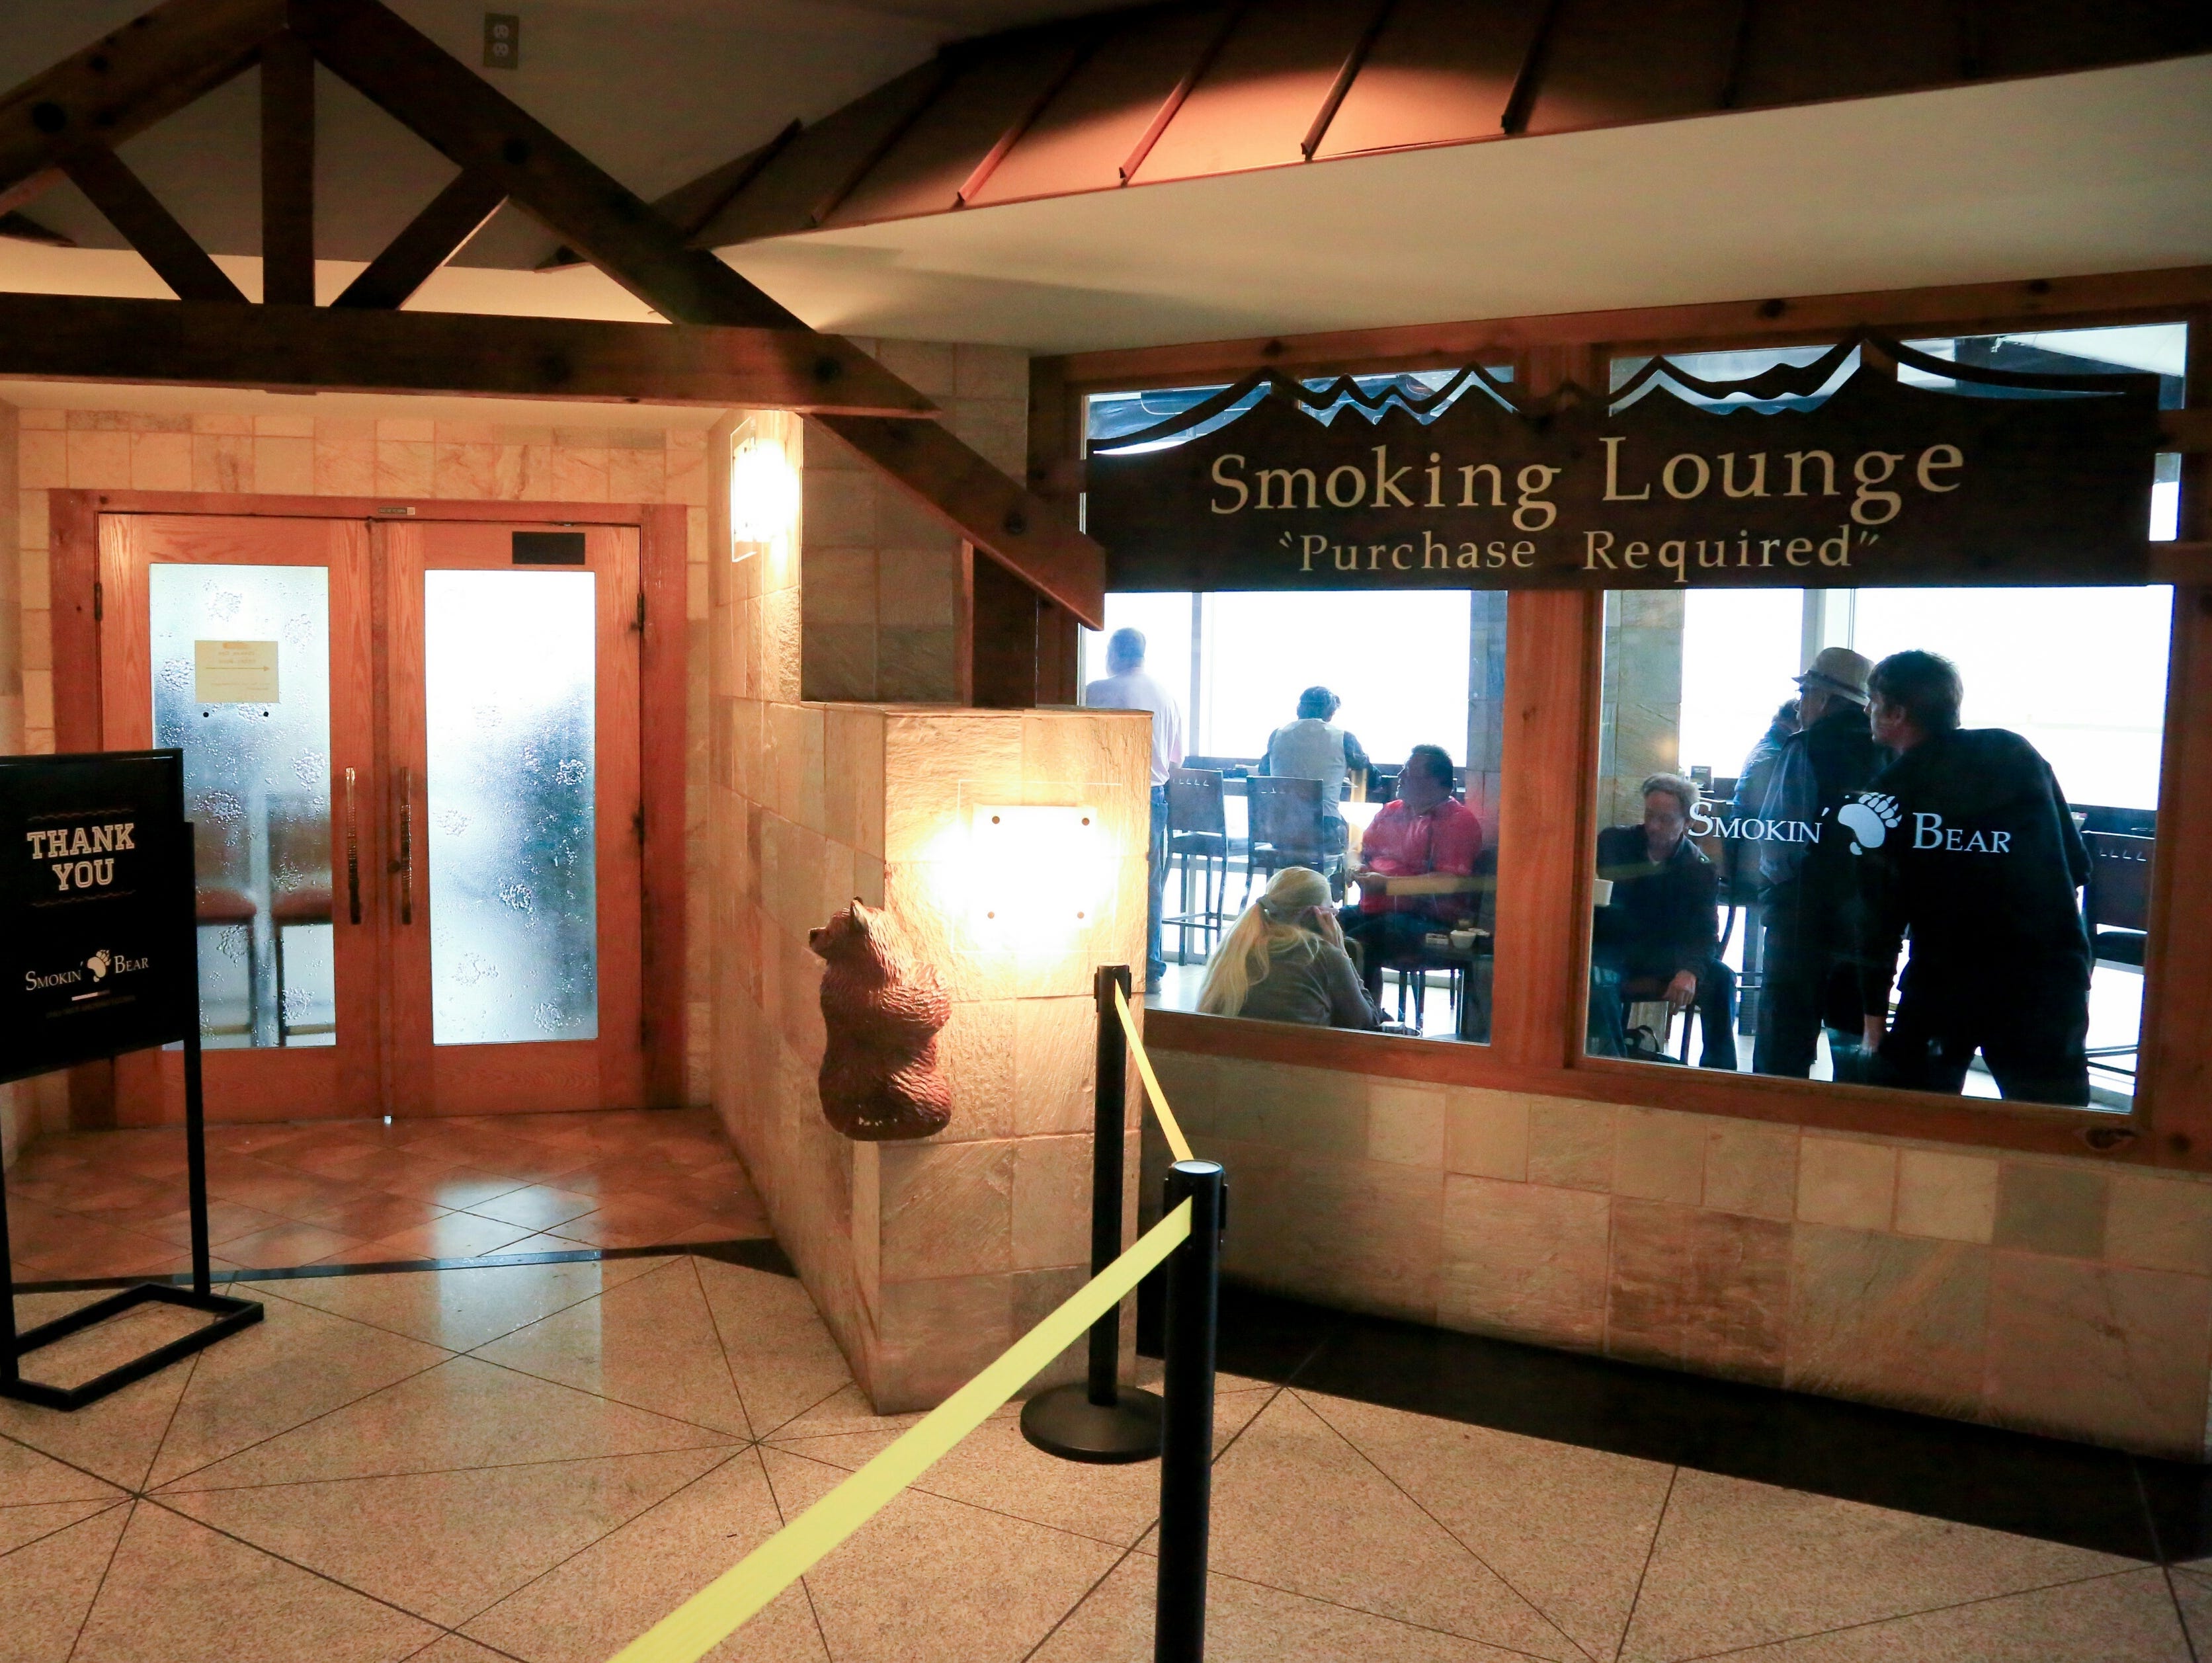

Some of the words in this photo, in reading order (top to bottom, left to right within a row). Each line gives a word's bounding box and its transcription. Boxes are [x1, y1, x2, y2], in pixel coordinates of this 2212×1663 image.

[1210, 445, 1561, 531] Smoking
[1599, 436, 1964, 526] Lounge
[1278, 529, 1536, 573] “Purchase
[1582, 524, 1881, 583] Required”
[26, 823, 136, 860] THANK
[1911, 812, 2012, 854] BEAR
[52, 858, 115, 891] YOU
[114, 955, 149, 974] BEAR
